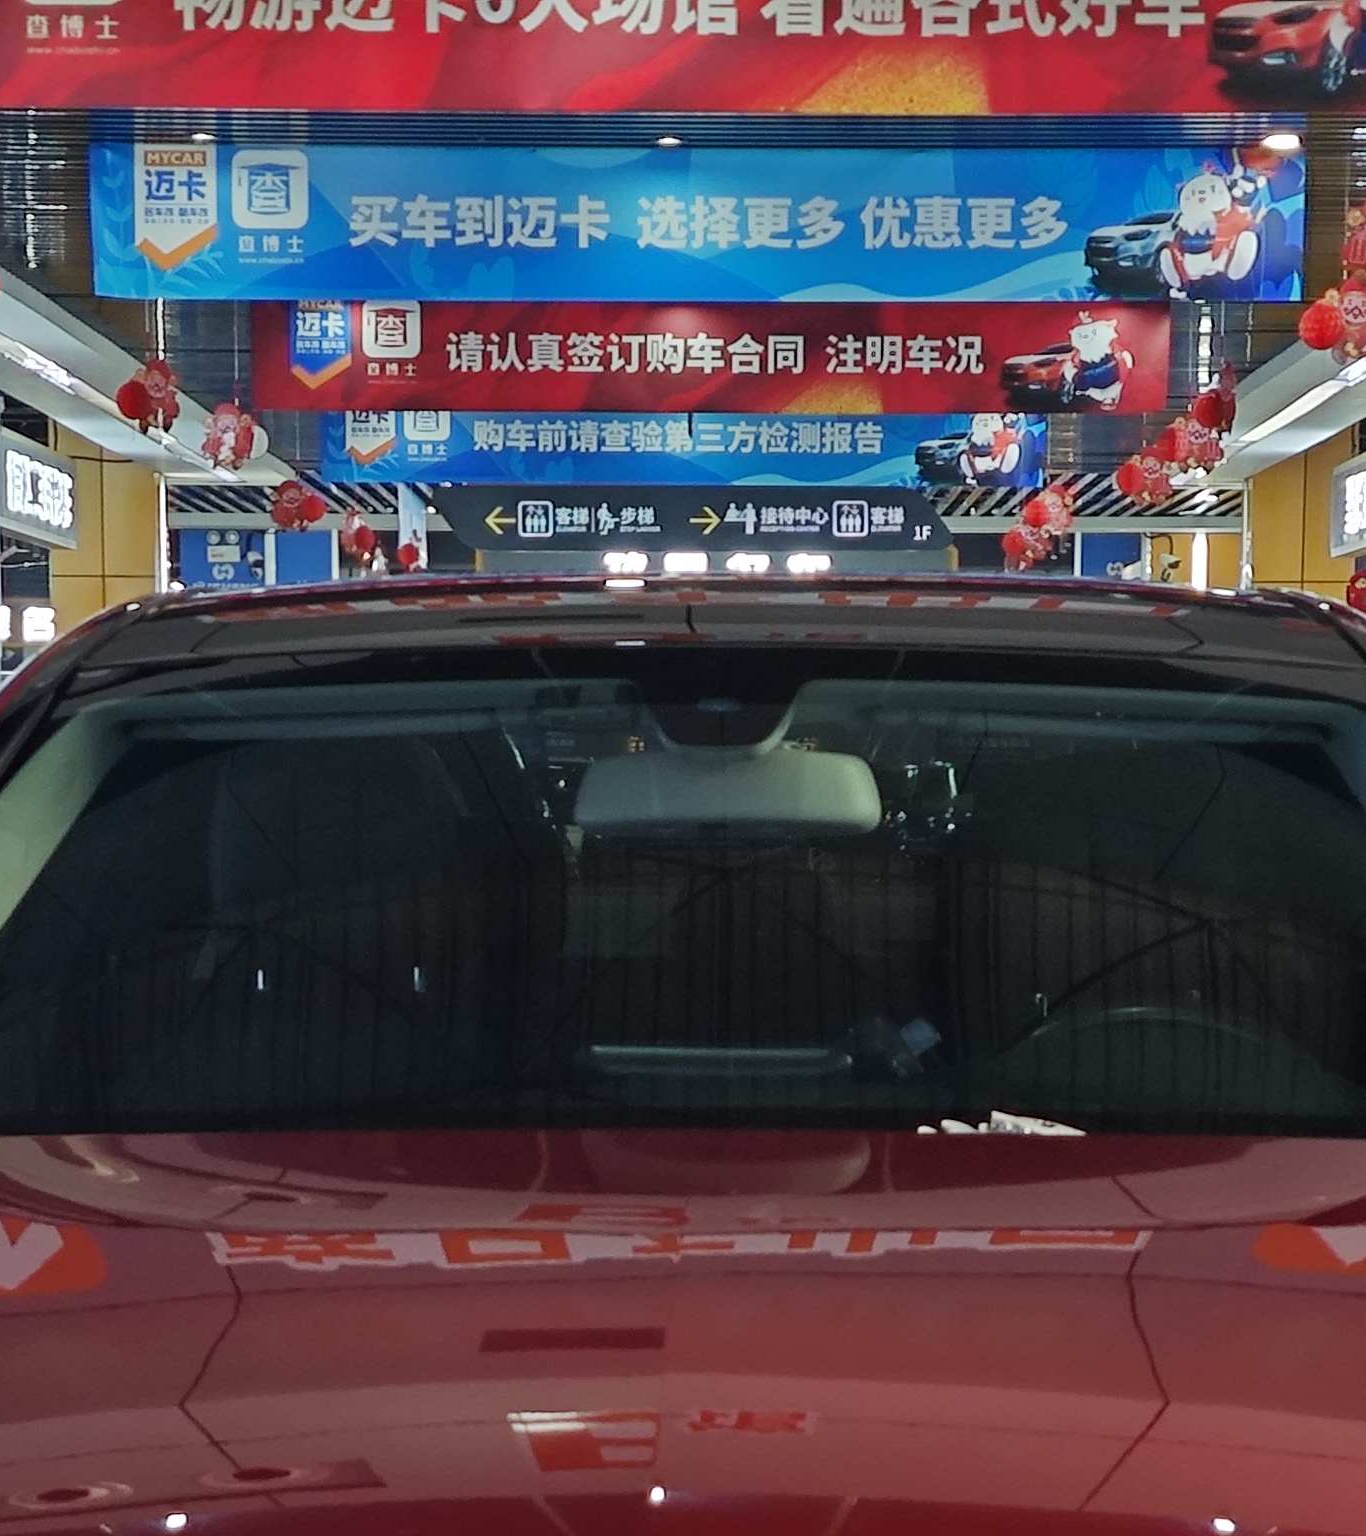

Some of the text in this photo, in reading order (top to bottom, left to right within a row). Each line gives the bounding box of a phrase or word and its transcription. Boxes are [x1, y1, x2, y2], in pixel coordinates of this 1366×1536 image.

[26, 14, 119, 39] 查博士
[146, 151, 206, 165] MYCAR
[144, 169, 207, 202] 迈卡
[349, 194, 1069, 250] 买车到迈卡 选择更多 优惠更多
[238, 235, 304, 253] 查博士
[295, 311, 345, 338] 迈卡
[445, 332, 985, 375] 请认真签订购车合同 注明车况
[473, 419, 884, 455] 购车前请查验第三方检测报告
[555, 506, 590, 525] 客梯
[619, 506, 656, 525] 步梯
[760, 506, 830, 525] 接待中心
[870, 506, 906, 525] 客梯
[913, 525, 933, 541] 1F
